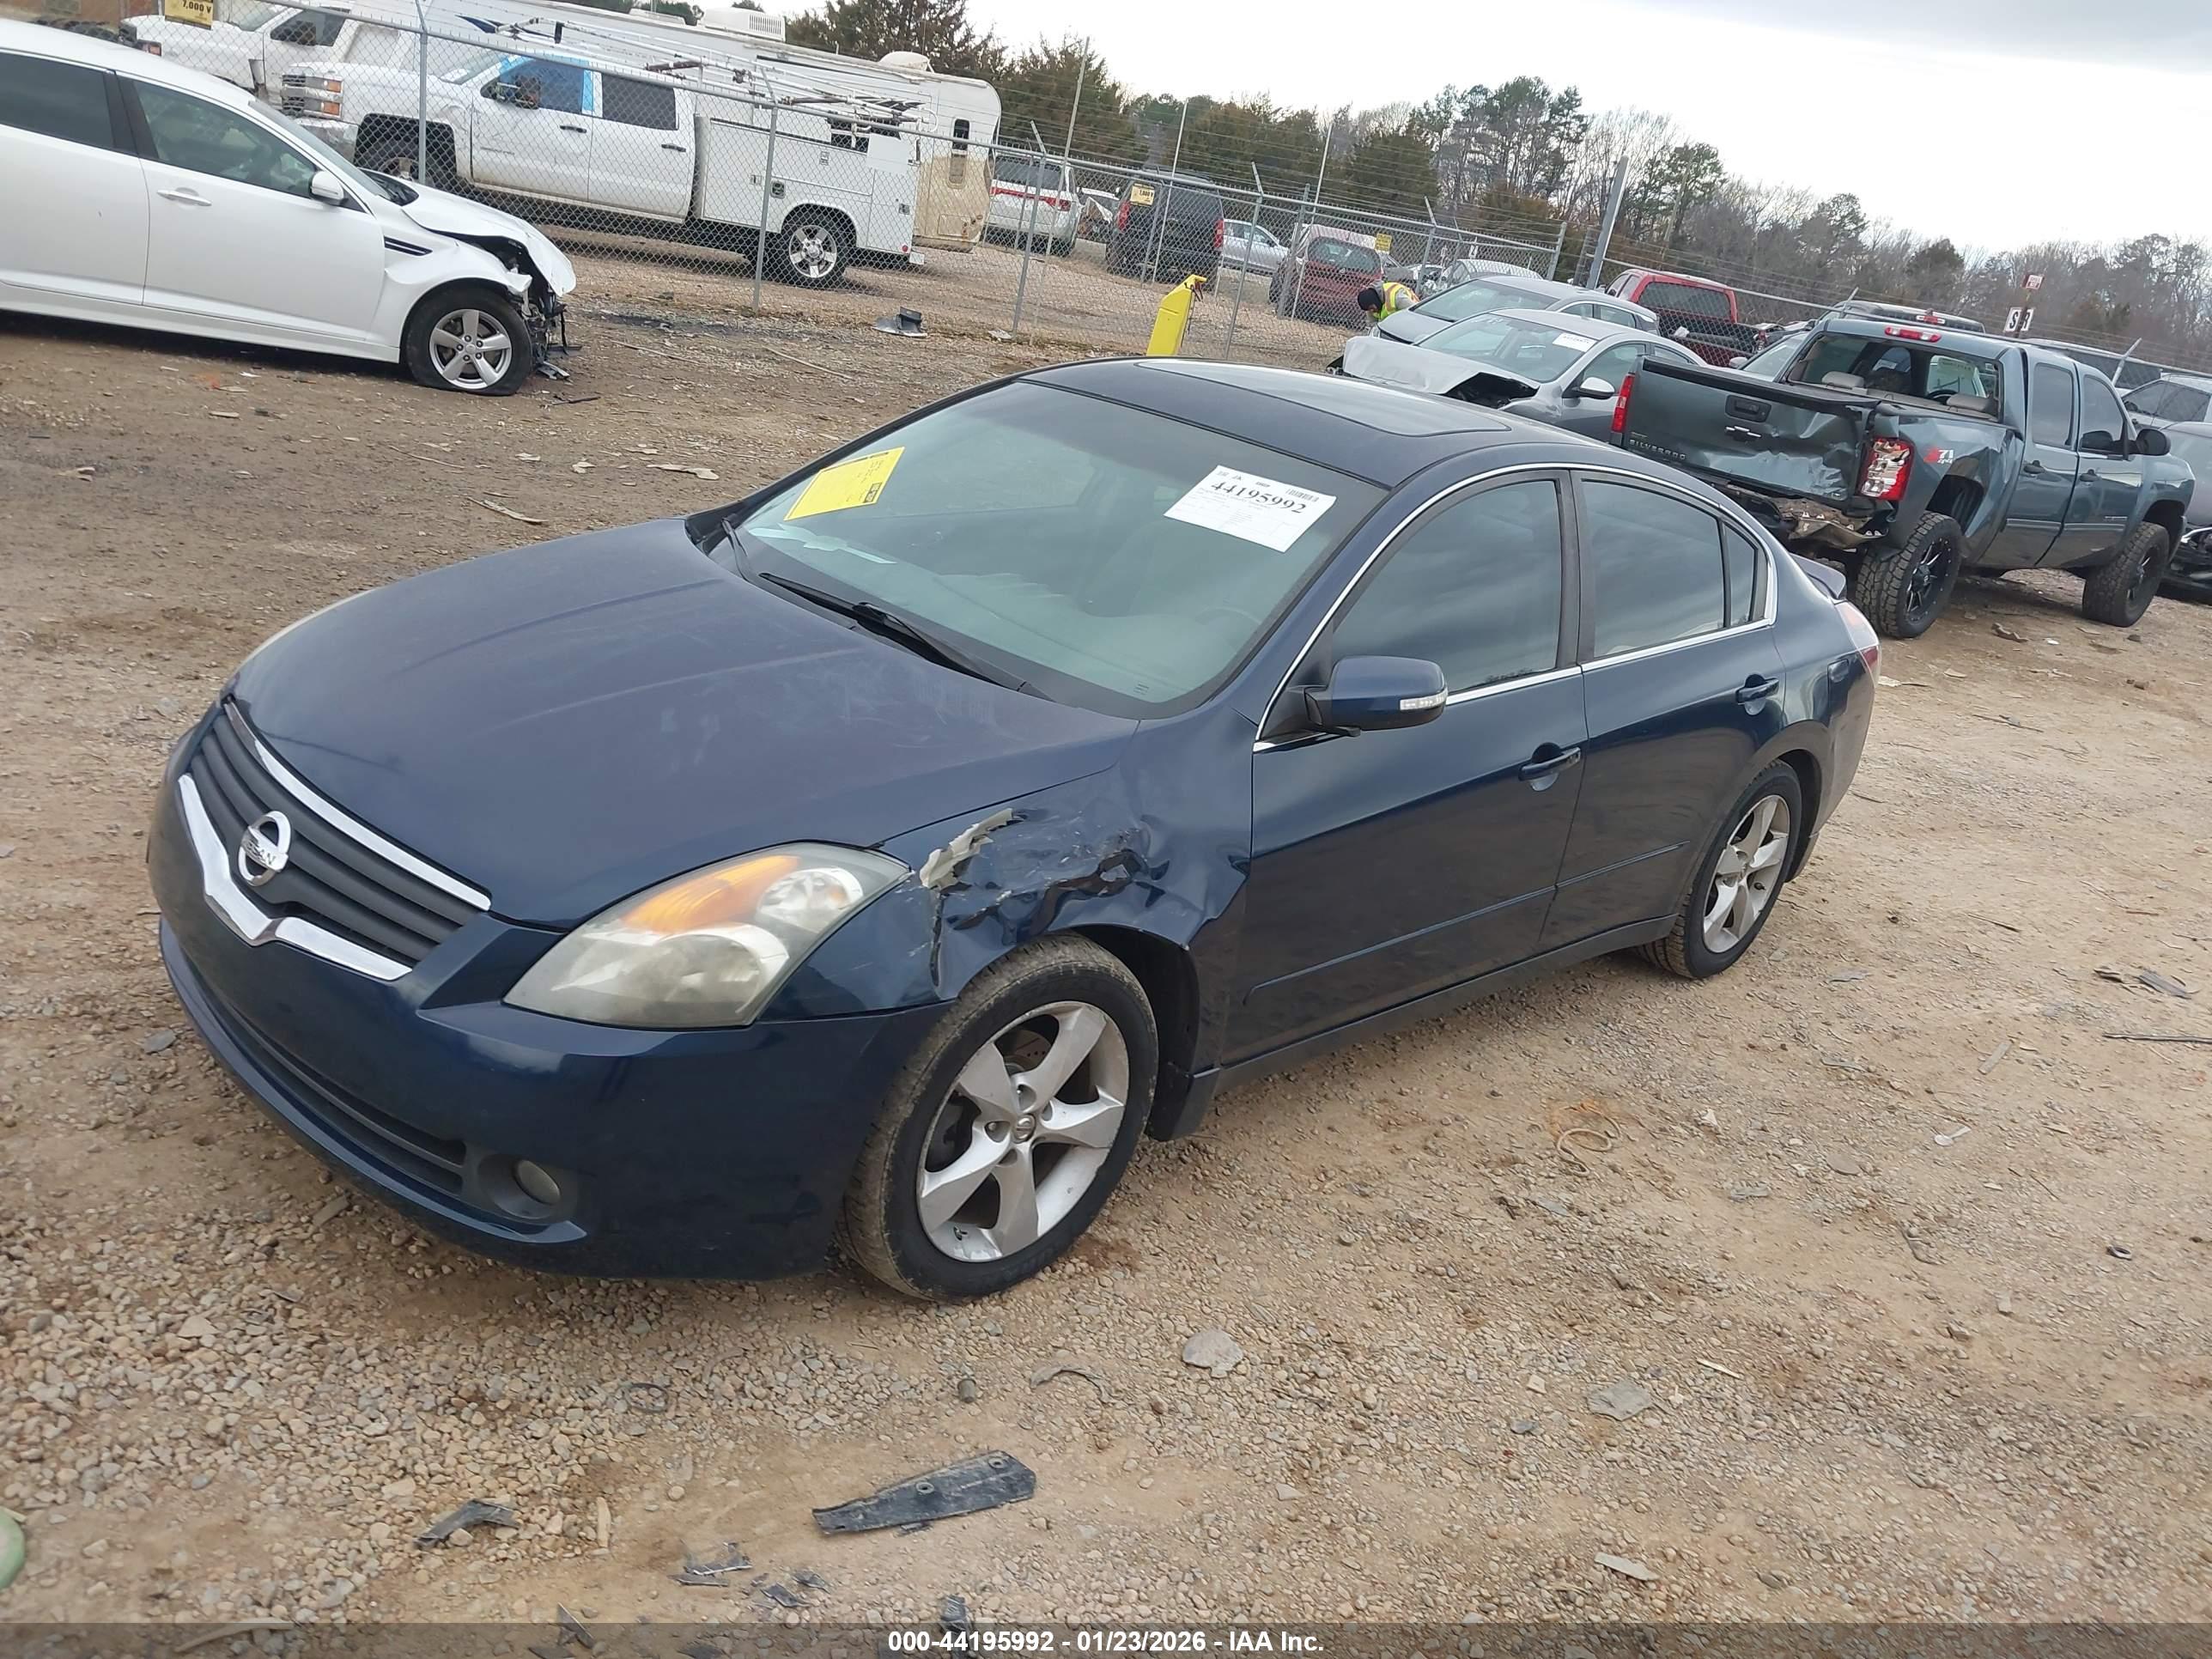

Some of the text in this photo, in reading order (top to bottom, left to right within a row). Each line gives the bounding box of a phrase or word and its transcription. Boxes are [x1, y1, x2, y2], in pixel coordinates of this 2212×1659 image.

[182, 0, 212, 14] 7,000 V
[2009, 311, 2020, 329] S
[1629, 439, 1686, 460] SILVERADO
[1211, 482, 1307, 514] 44195992
